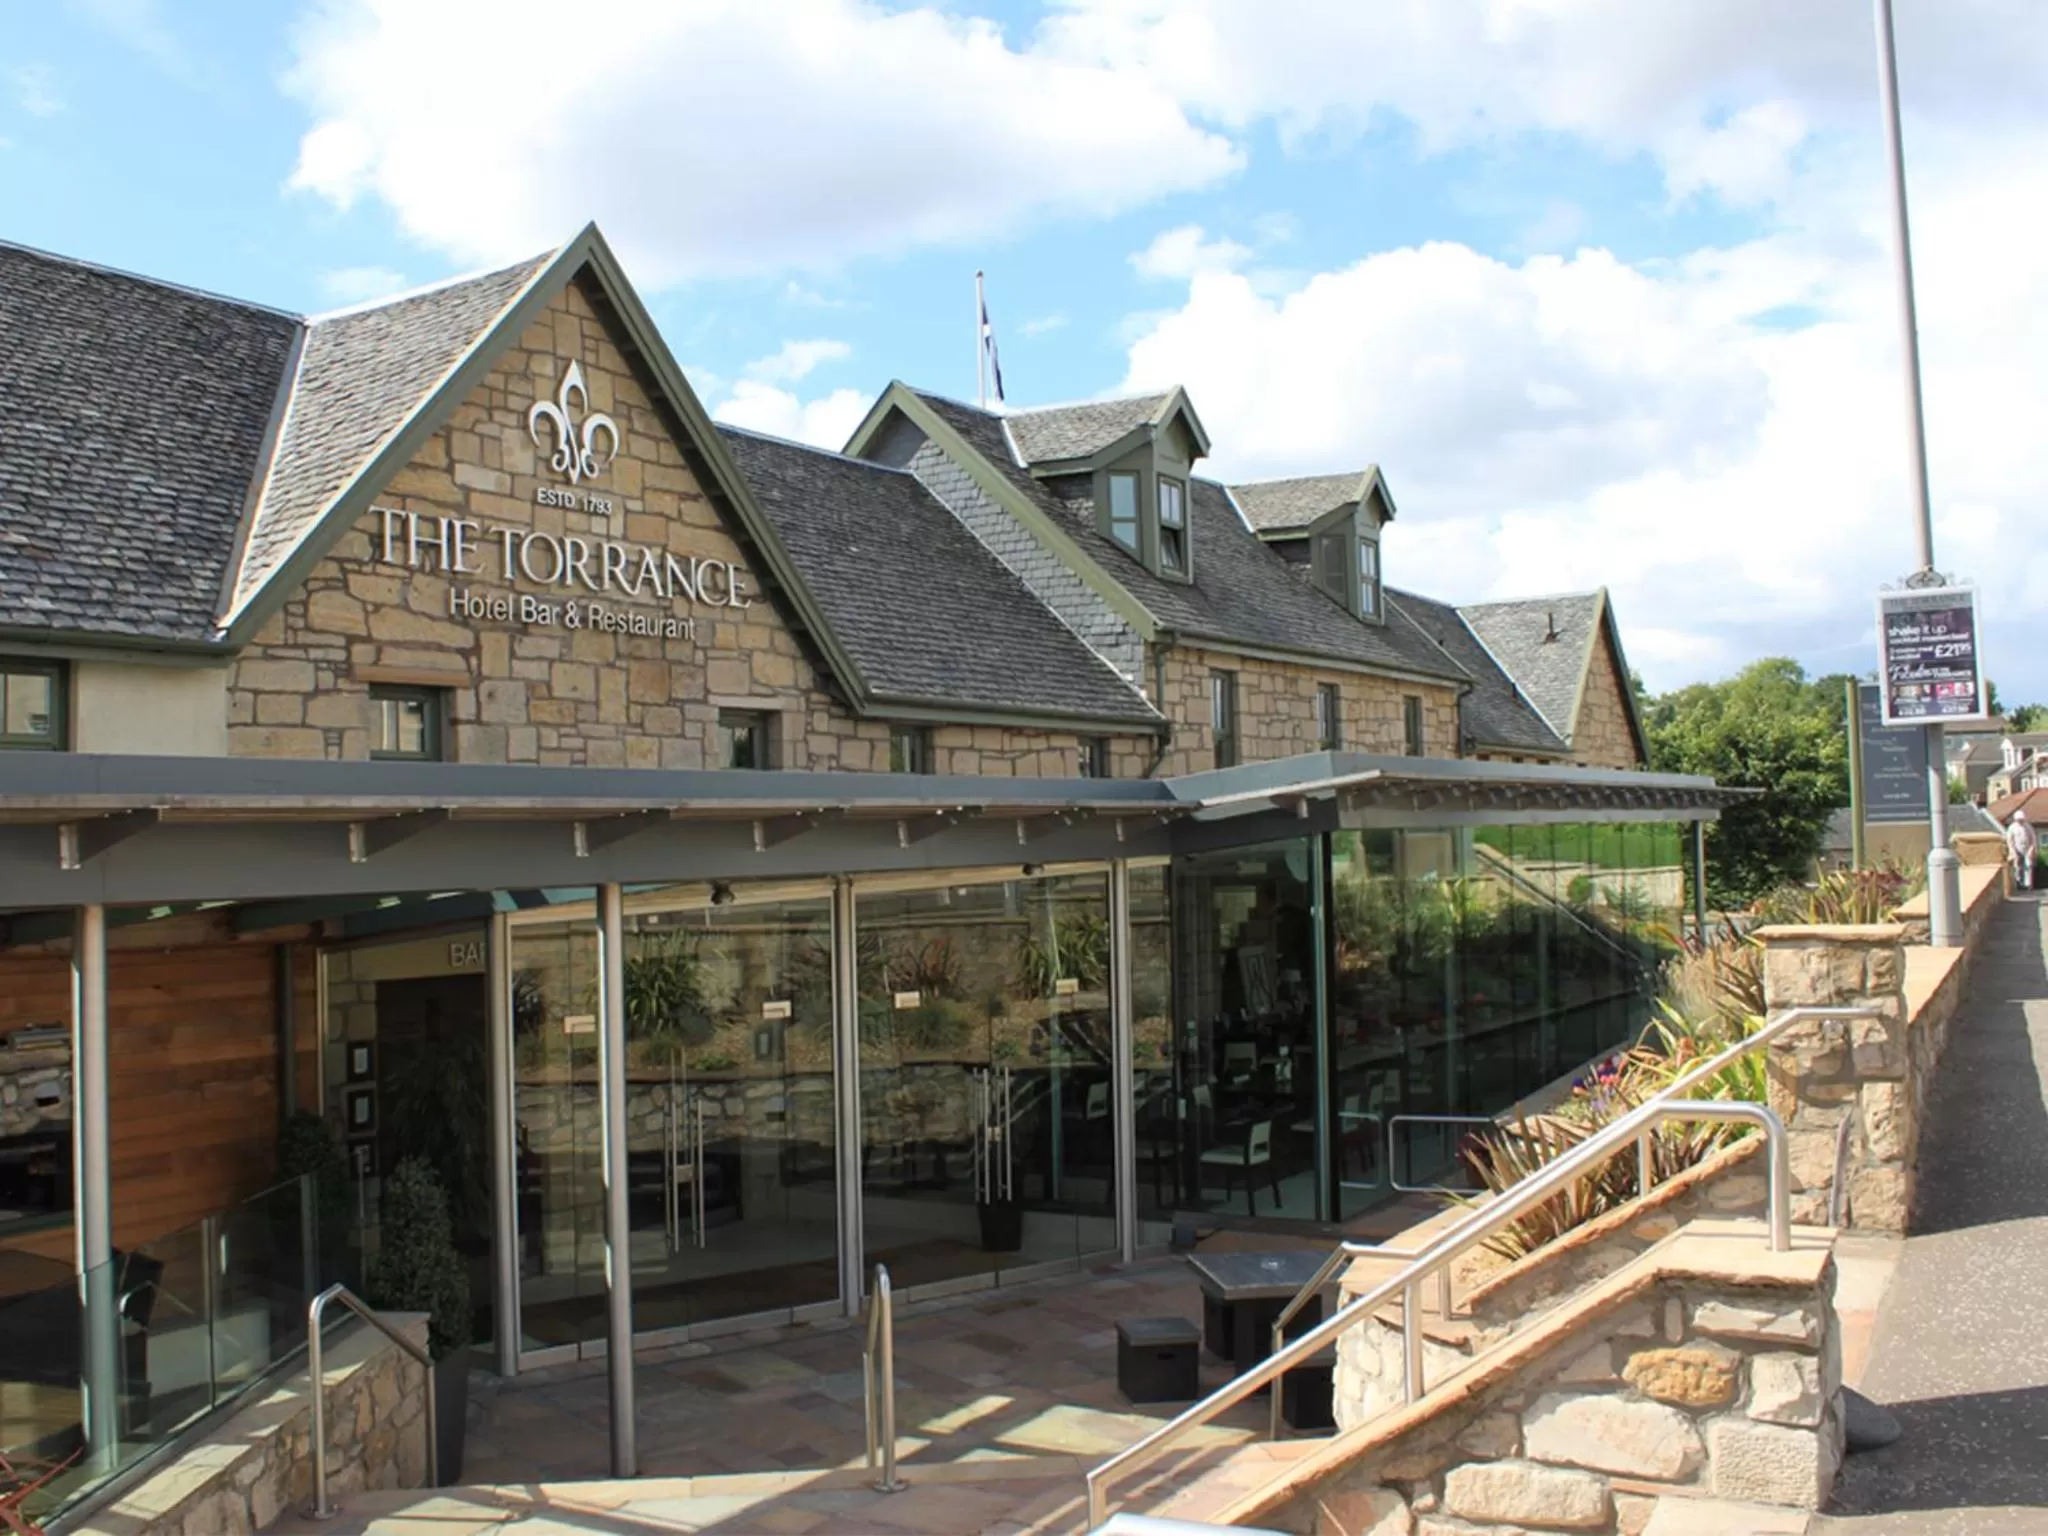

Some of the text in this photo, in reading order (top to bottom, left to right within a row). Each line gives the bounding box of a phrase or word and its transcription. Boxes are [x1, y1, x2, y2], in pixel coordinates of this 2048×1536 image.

[582, 496, 613, 516] 1793
[368, 505, 753, 610] THE TORRANCE
[450, 586, 697, 641] Hotel Bar & Restaurant
